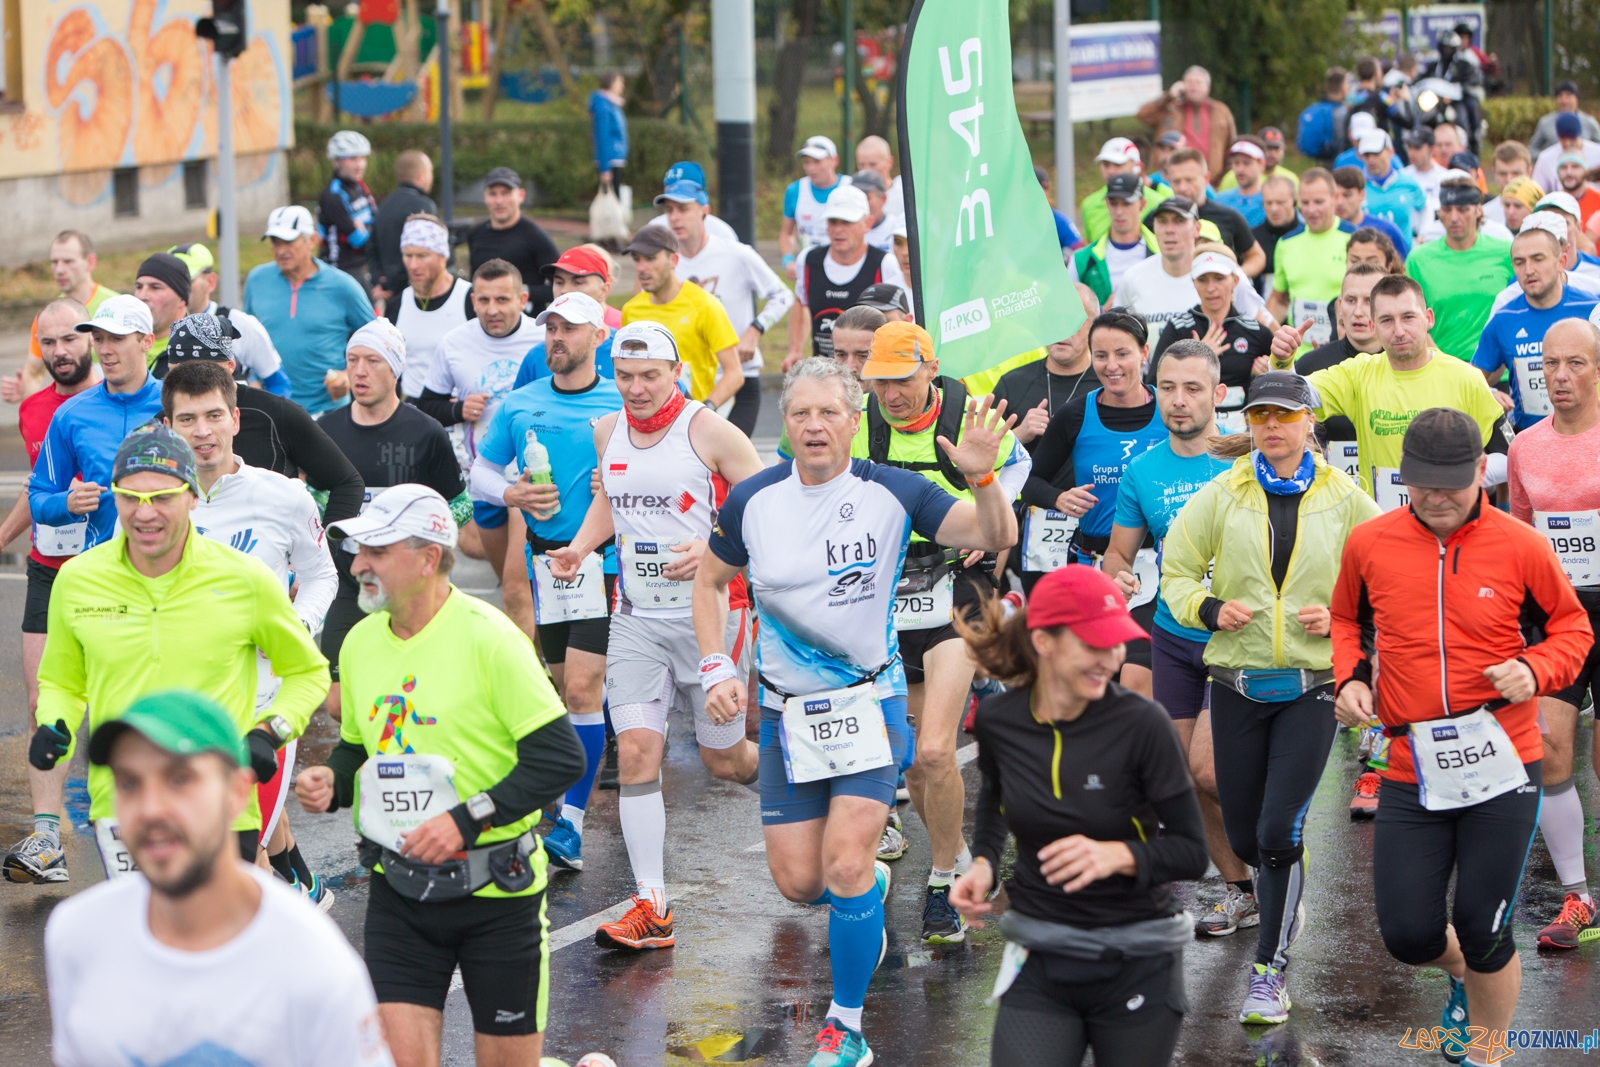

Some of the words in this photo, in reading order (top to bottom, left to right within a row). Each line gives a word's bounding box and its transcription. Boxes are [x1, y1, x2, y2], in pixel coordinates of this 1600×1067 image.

[938, 37, 995, 247] 3:45
[994, 295, 1042, 319] maraton
[944, 309, 983, 333] 17.PKO
[1093, 464, 1119, 475] Grupa
[55, 528, 77, 536] Paweł
[826, 533, 877, 566] krab
[1550, 536, 1596, 553] 1998
[1562, 557, 1590, 565] Andrzej
[806, 702, 830, 712] 17.PKO
[809, 716, 860, 742] 1878
[1433, 729, 1457, 738] 17.PKO
[822, 741, 854, 753] Roman
[1435, 740, 1497, 770] 6364
[379, 766, 403, 776] 17.PKO
[1461, 770, 1479, 780] Jan
[382, 790, 434, 812] 5517
